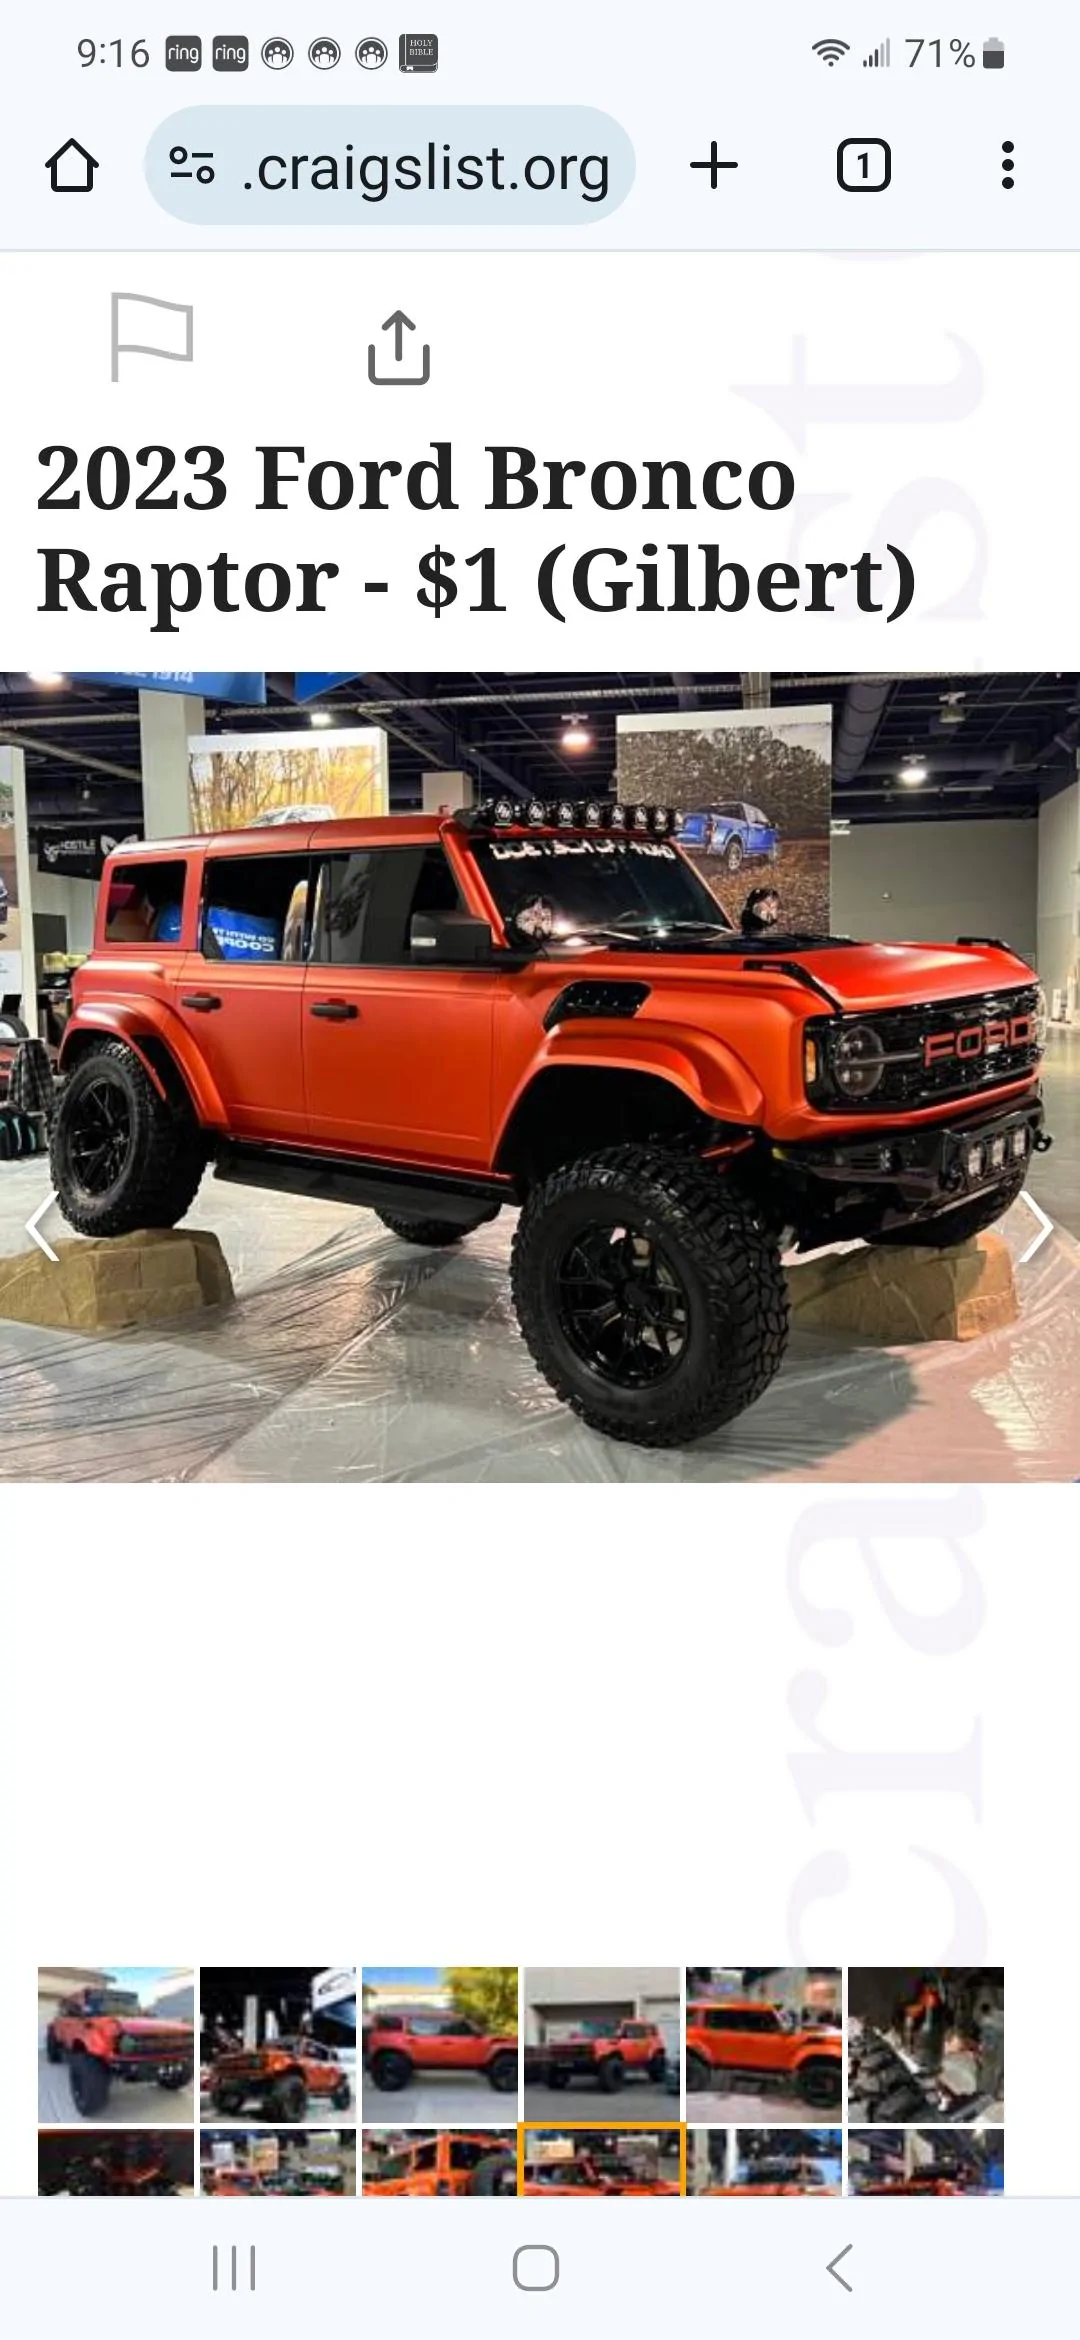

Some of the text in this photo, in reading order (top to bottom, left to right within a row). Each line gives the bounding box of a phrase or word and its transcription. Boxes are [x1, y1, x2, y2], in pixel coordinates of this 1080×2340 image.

[77, 38, 150, 68] 9:16
[168, 43, 199, 64] ring
[215, 43, 246, 64] ring
[409, 39, 433, 47] HOLY
[409, 48, 434, 56] BIBLE
[904, 38, 976, 68] 71%
[243, 141, 609, 203] .craigslist.org
[37, 441, 795, 511] 2023 Ford Bronco
[36, 542, 340, 633] Raptor
[416, 545, 507, 622] $1
[537, 542, 915, 633] (Gilbert)
[923, 1015, 1036, 1068] FORD
